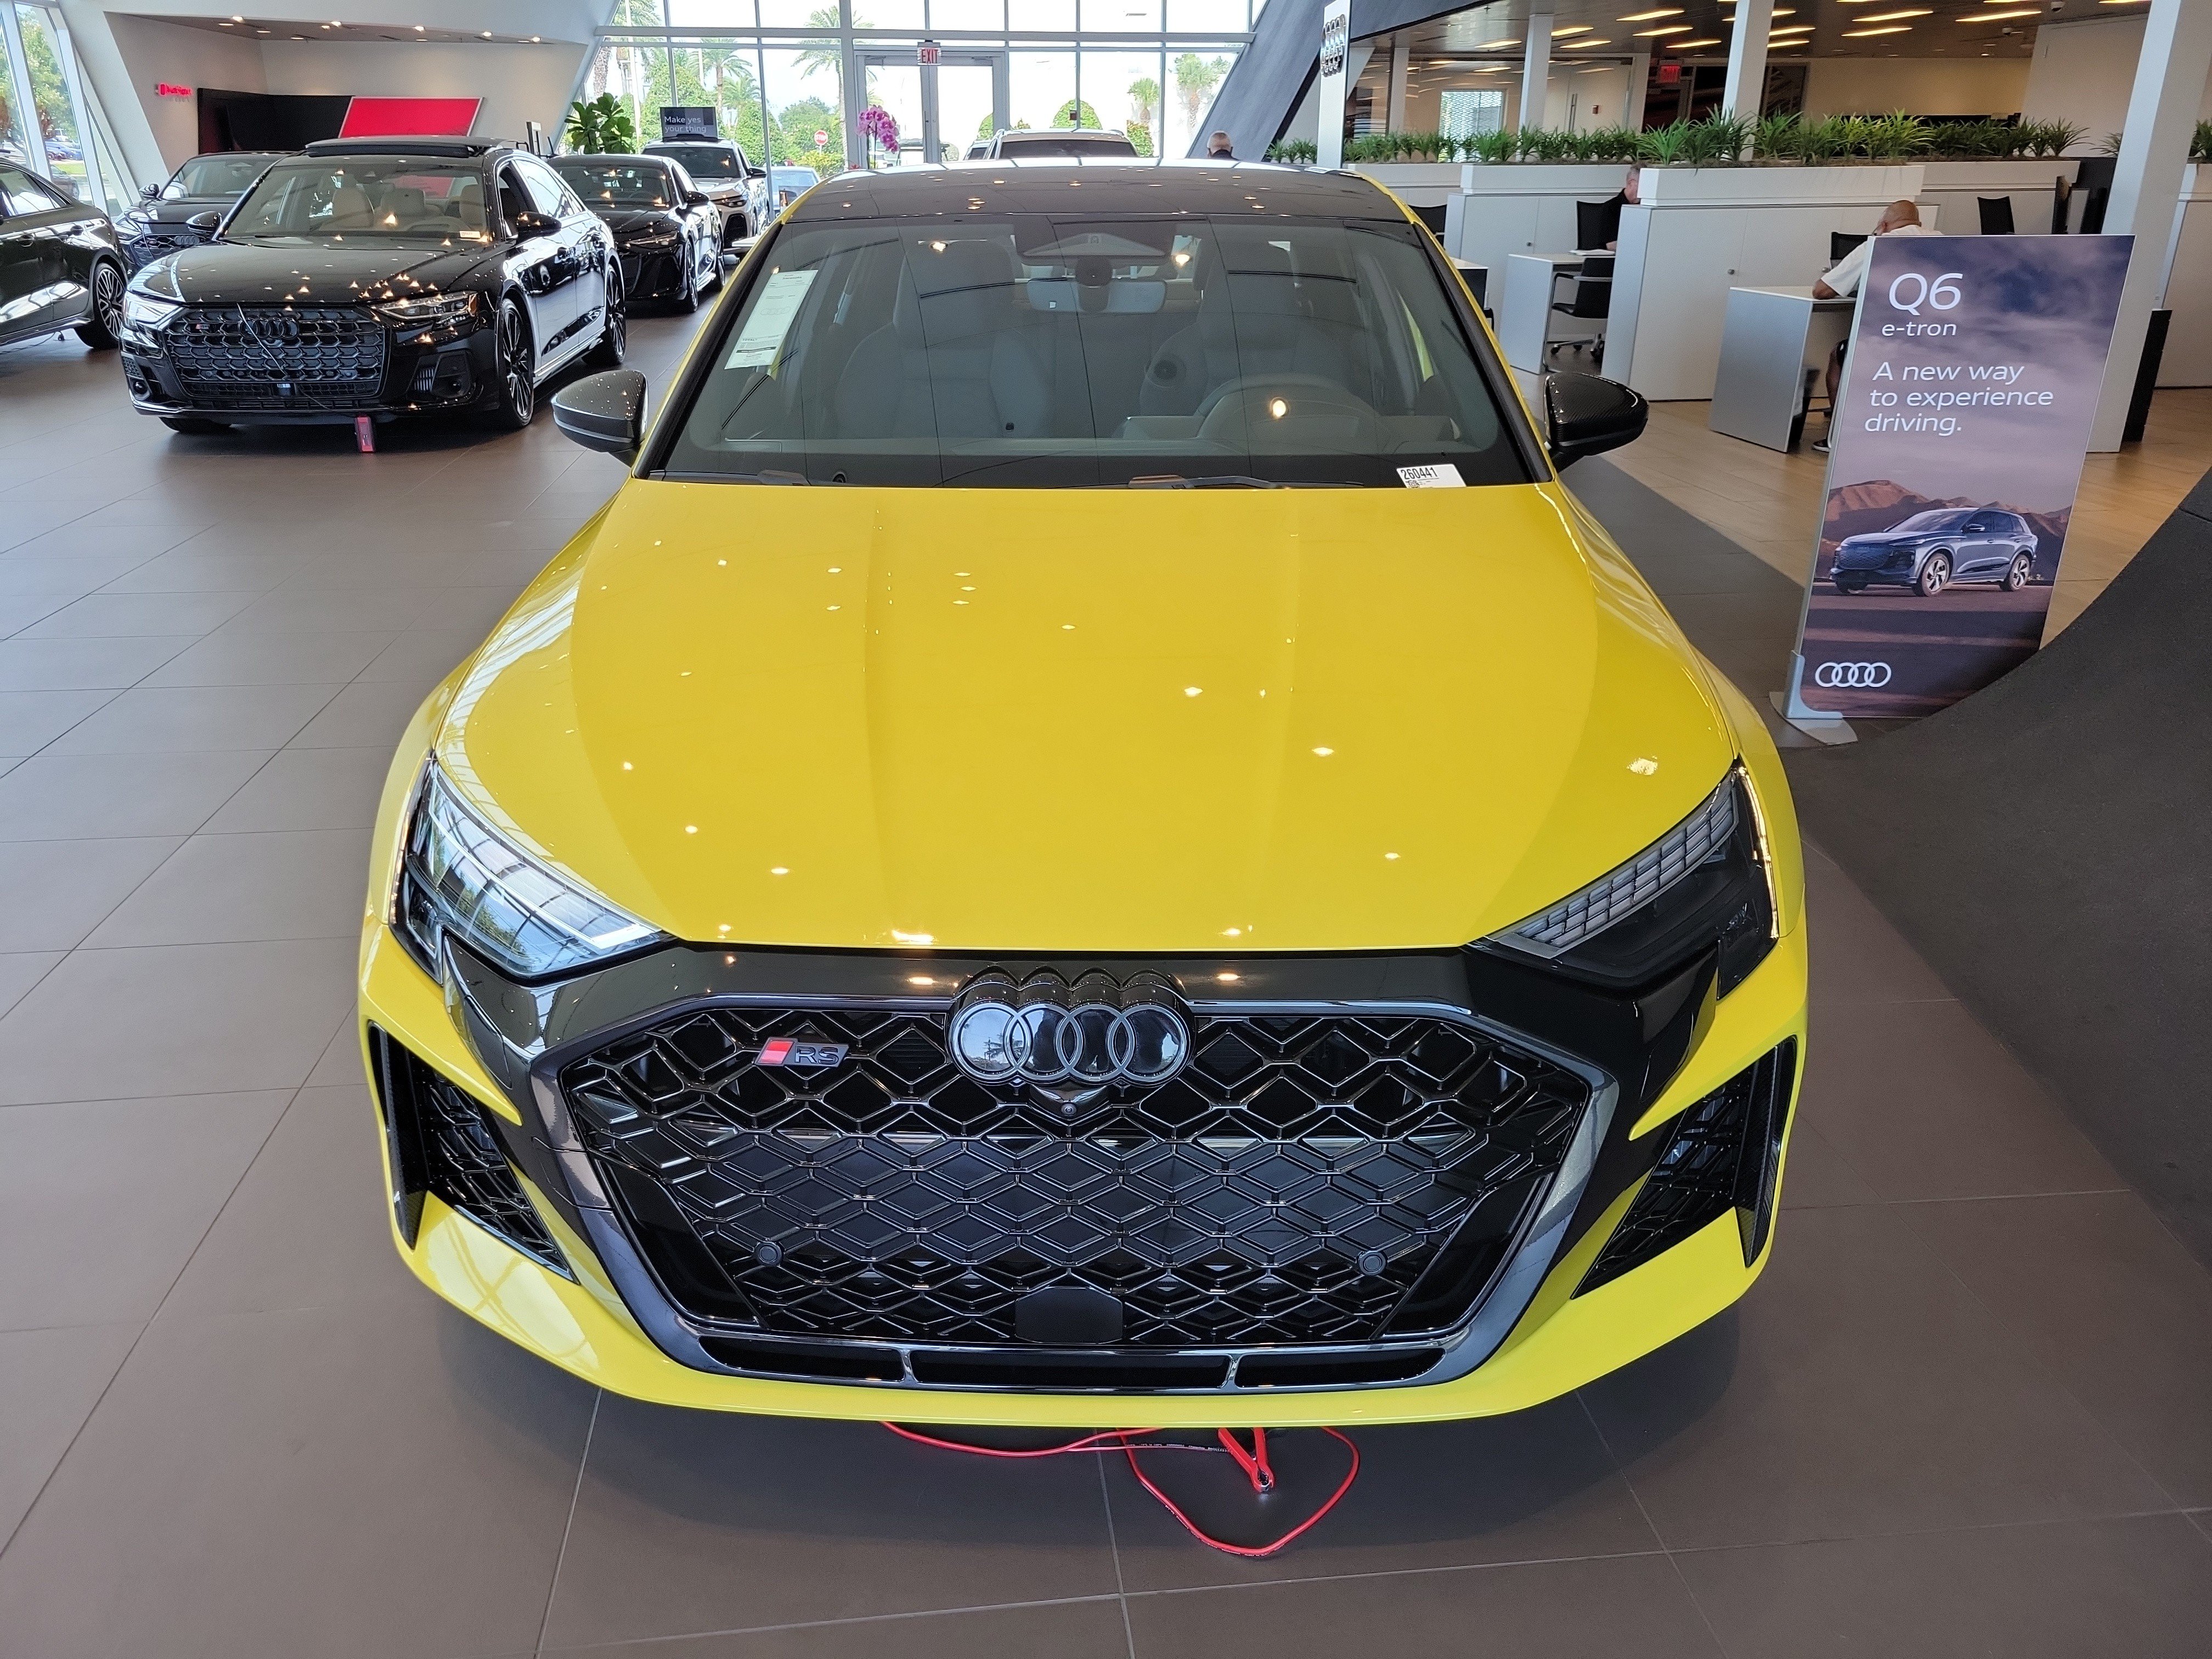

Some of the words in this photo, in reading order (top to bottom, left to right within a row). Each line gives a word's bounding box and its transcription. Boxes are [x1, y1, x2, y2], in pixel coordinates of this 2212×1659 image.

[922, 49, 938, 64] EXIT
[686, 125, 707, 134] thing
[1889, 273, 1963, 315] Q6
[1882, 321, 1957, 336] e-tron
[1872, 362, 1893, 381] A
[1902, 366, 1962, 380] new
[1968, 365, 2025, 385] way
[1870, 390, 1898, 407] to
[1906, 387, 2053, 411] experience
[1865, 413, 1962, 436] driving.
[1401, 467, 1437, 480] 260441
[795, 1046, 839, 1065] RS
